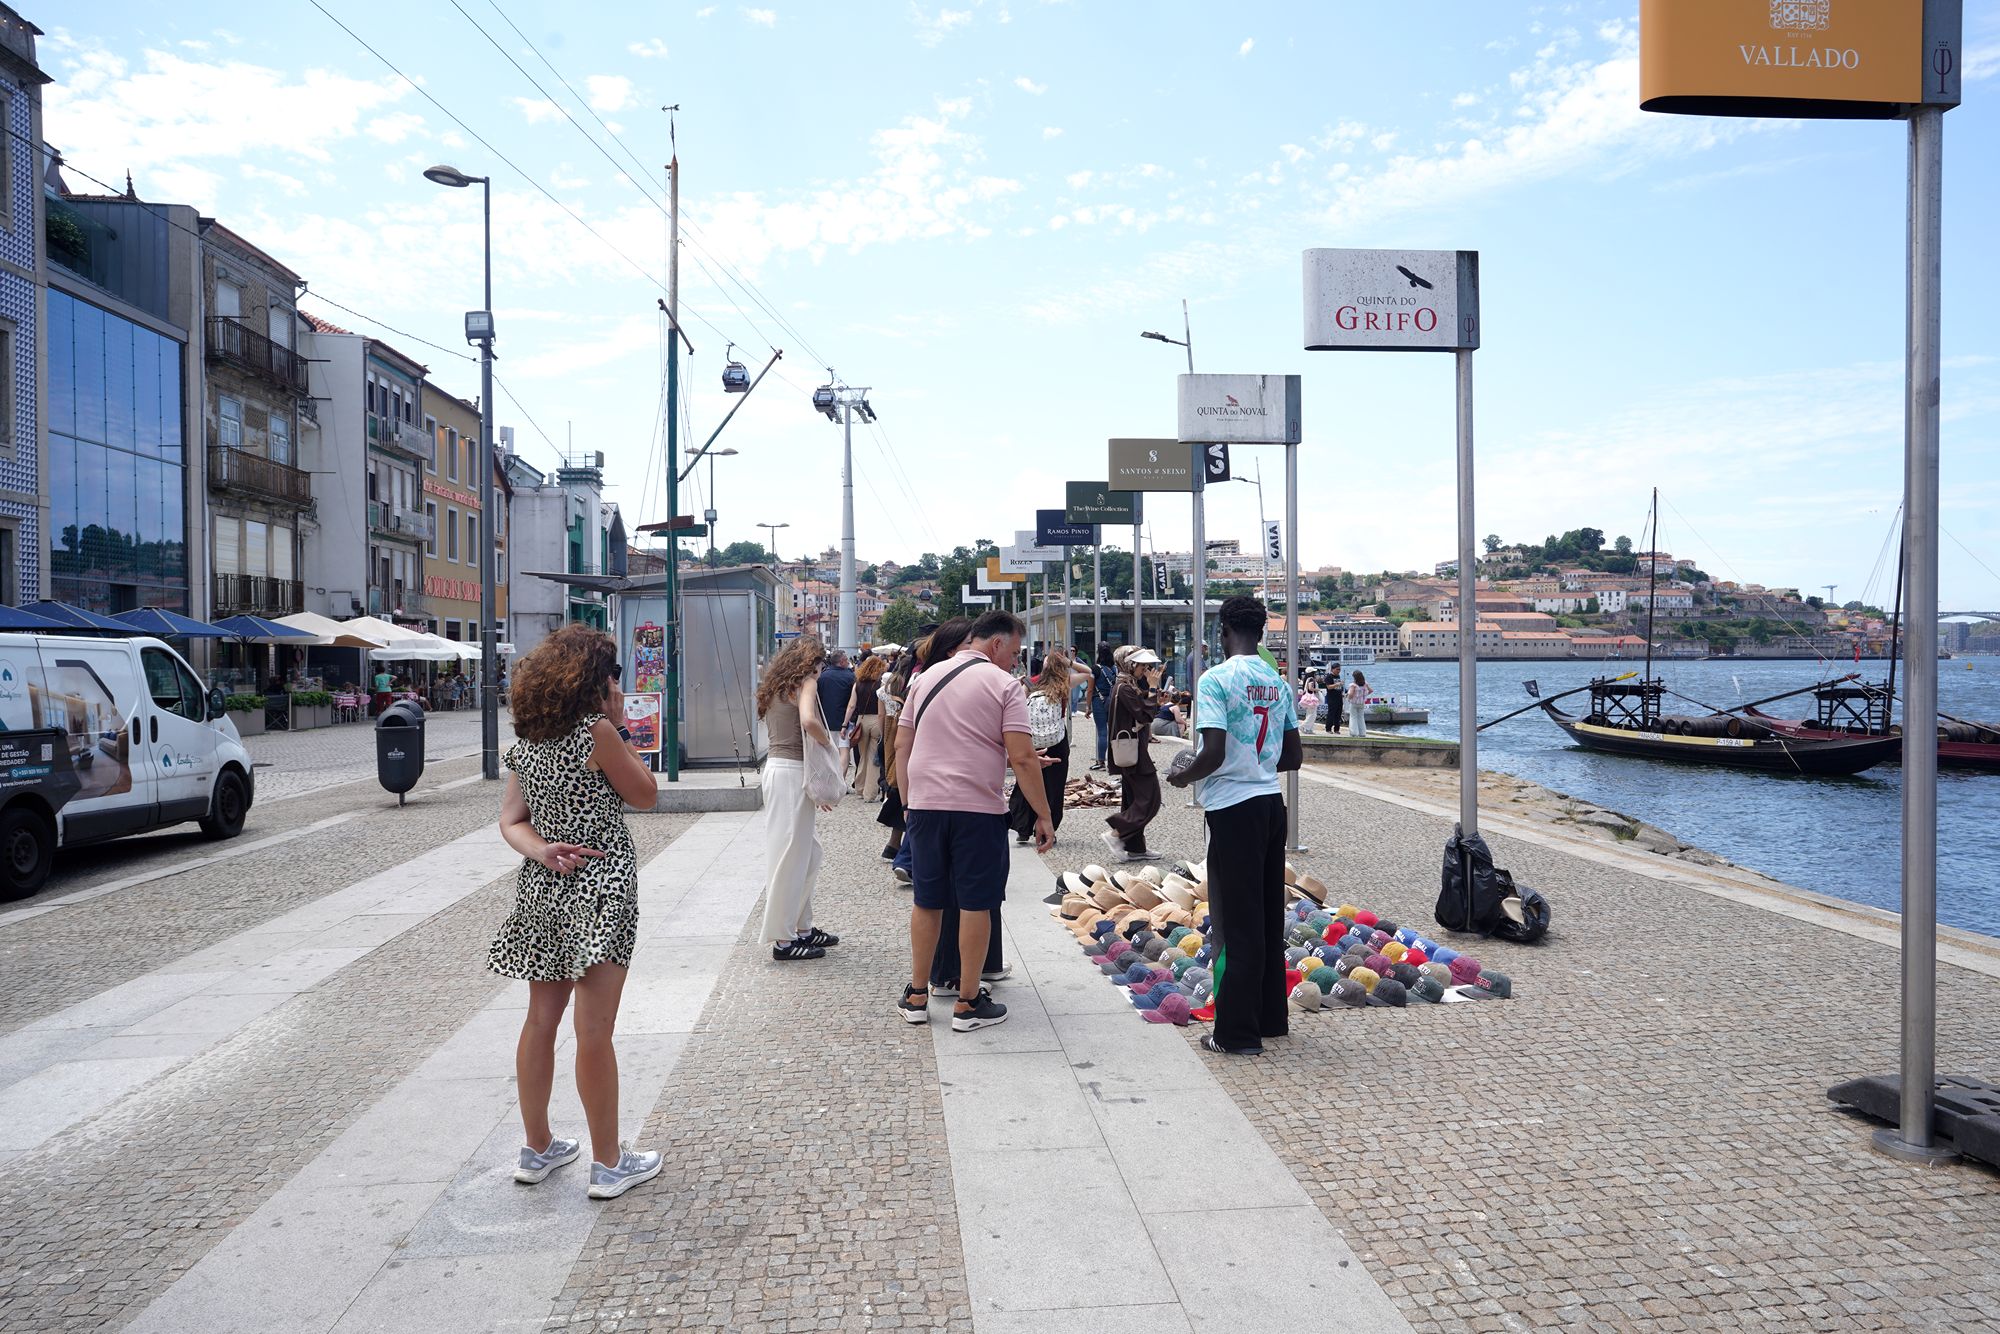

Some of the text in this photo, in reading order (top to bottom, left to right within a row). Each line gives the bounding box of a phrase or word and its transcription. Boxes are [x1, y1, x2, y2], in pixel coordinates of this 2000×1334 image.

[1739, 45, 1860, 70] VALLADO
[1356, 296, 1417, 306] QUINTA DO
[1335, 305, 1438, 332] GRIFO
[1197, 406, 1229, 416] QUINTA
[1240, 407, 1268, 416] NOVAL
[1120, 467, 1152, 475] SANTOS
[1161, 467, 1186, 475] SEIXO
[1208, 444, 1226, 475] GA
[1269, 525, 1280, 560] GAIA
[1253, 705, 1270, 765] 7
